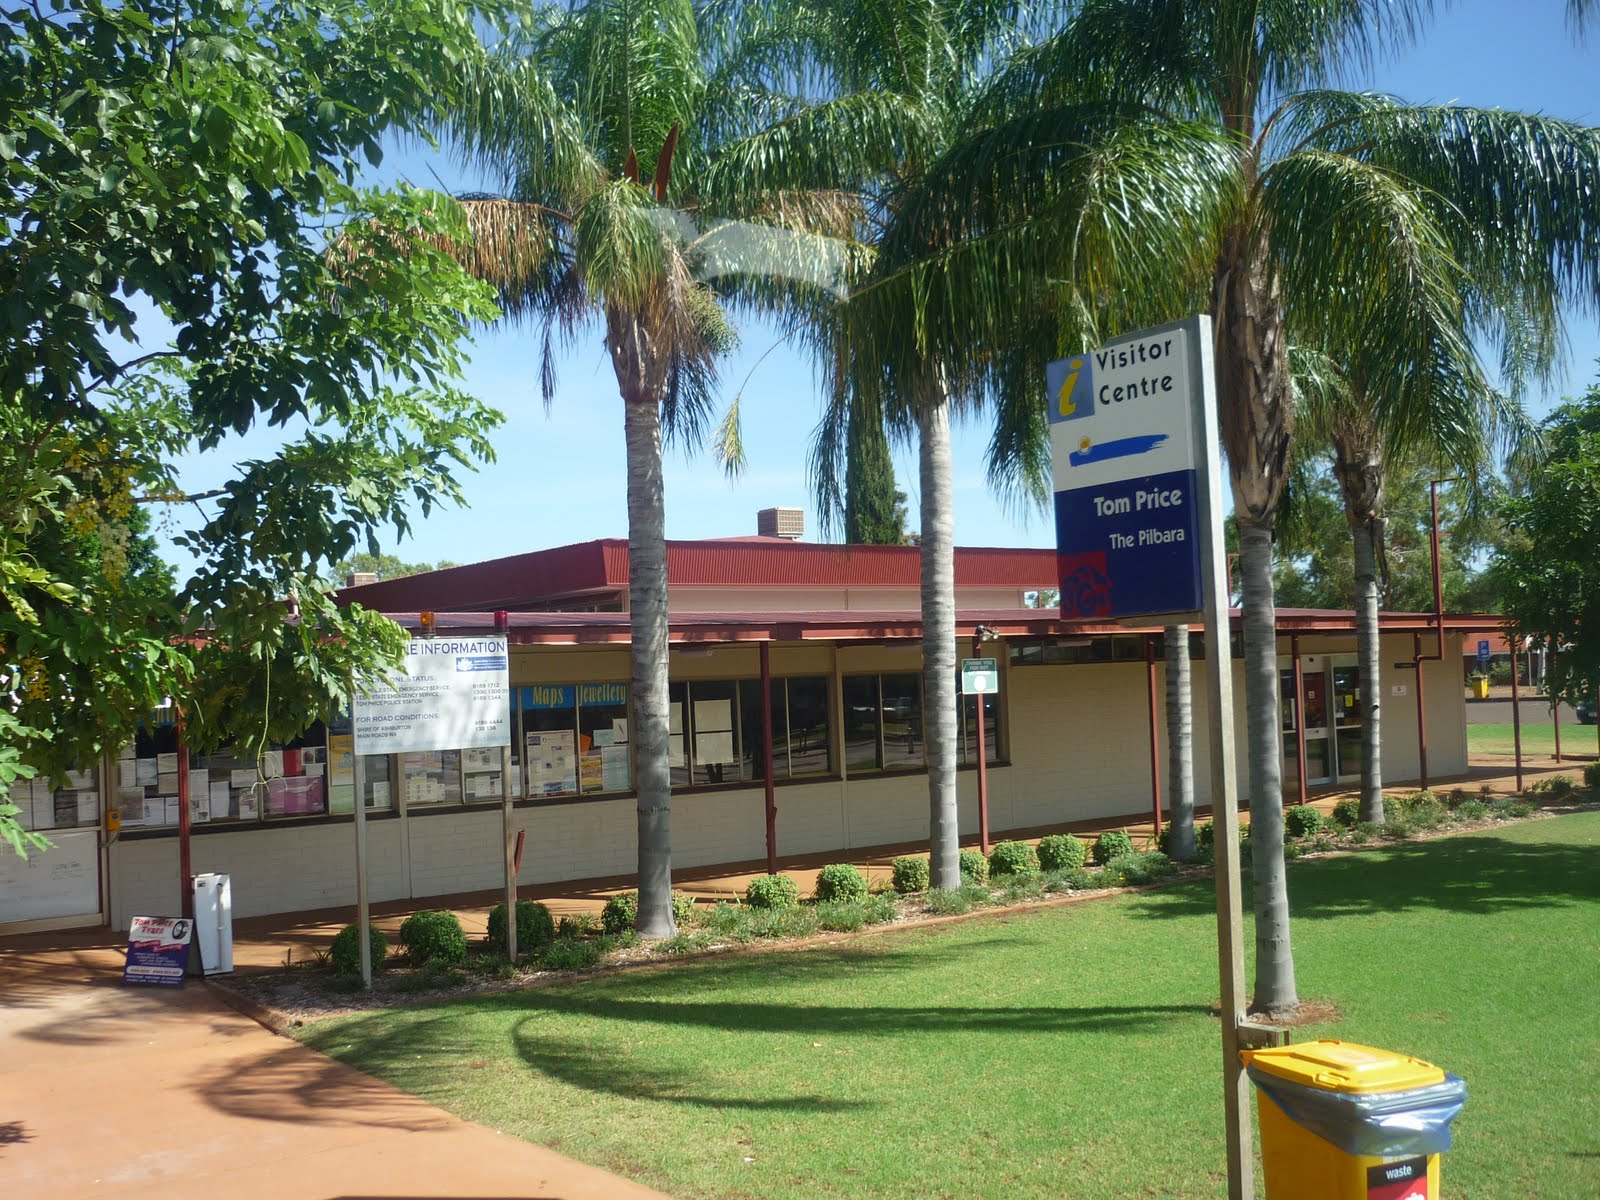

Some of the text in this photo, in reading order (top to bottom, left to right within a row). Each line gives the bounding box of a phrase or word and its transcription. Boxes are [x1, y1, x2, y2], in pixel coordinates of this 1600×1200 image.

[1096, 339, 1172, 371] Visitor
[1099, 375, 1173, 405] Centre
[1093, 487, 1182, 517] Tom Price
[1109, 528, 1185, 550] The Pilbara
[421, 641, 505, 655] INFORMATION
[533, 686, 564, 708] Maps
[580, 684, 626, 706] Jewellery
[1386, 1165, 1412, 1180] waste
